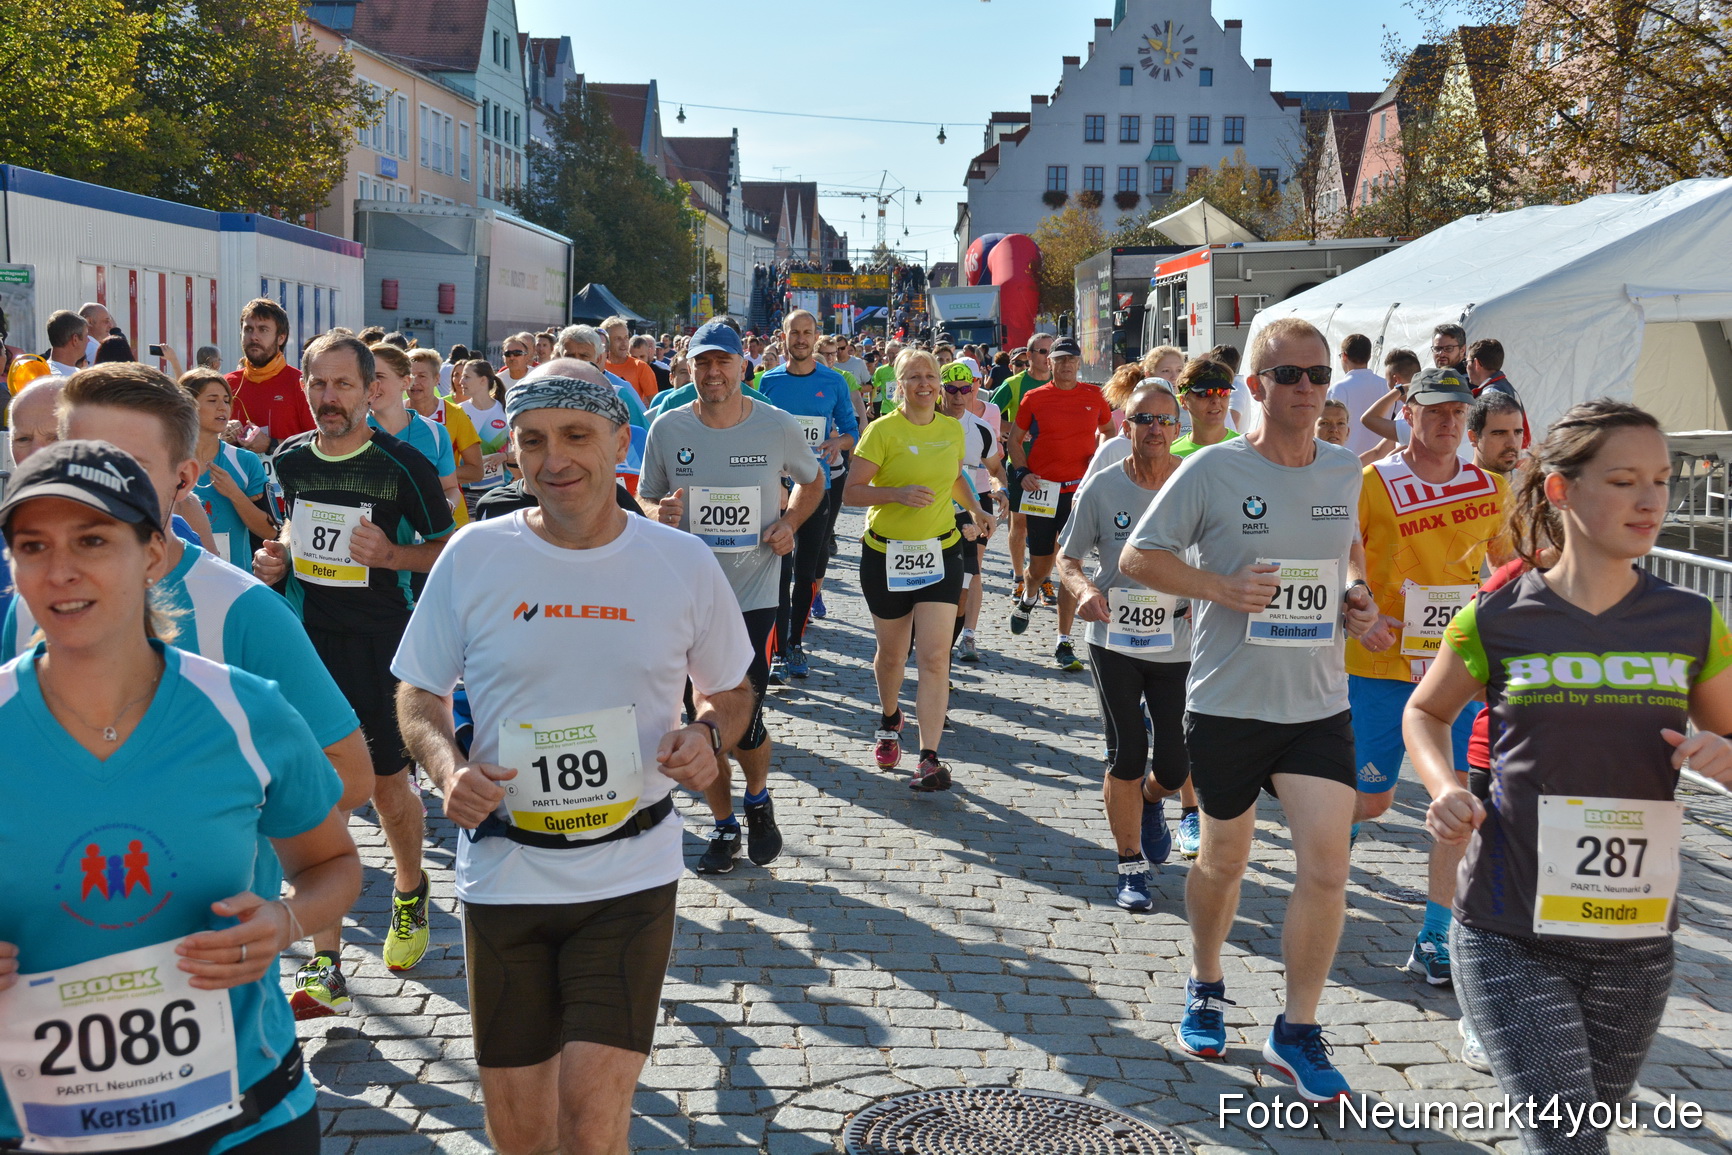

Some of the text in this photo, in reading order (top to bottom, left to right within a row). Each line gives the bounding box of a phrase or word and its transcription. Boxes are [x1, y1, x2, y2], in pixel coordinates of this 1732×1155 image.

[822, 274, 857, 286] START
[730, 455, 767, 465] BOCK
[67, 463, 122, 493] PUMA
[710, 493, 740, 501] BOCK
[1028, 489, 1048, 502] 201
[311, 509, 346, 523] BOCK
[700, 505, 750, 526] 2092
[1028, 505, 1046, 513] Volkmar
[1312, 506, 1349, 517] BOCK
[1399, 502, 1500, 537] MAX BÖGL
[312, 526, 341, 552] 87
[715, 537, 736, 546] Jack
[303, 551, 343, 563] PARTL Neumarkt
[894, 552, 935, 570] 2542
[312, 564, 337, 578] Peter
[1281, 568, 1318, 578] BOCK
[906, 577, 926, 586] Sonja
[1128, 594, 1157, 603] BOCK
[1266, 584, 1327, 611] 2190
[1428, 592, 1460, 600] BOCK
[544, 604, 635, 622] KLEBL
[1119, 605, 1165, 627] 2489
[1270, 625, 1317, 637] Reinhard
[1131, 637, 1151, 646] Peter
[1501, 652, 1695, 693] BOCK
[1508, 692, 1564, 706] inspired
[1569, 692, 1589, 706] by
[1594, 693, 1643, 704] smart
[534, 725, 597, 745] BOCK
[532, 750, 608, 793] 189
[1358, 773, 1388, 783] adidas
[532, 794, 604, 807] PARTL Neumarkt
[544, 812, 609, 832] Guenter
[1584, 809, 1645, 825] BOCK
[1576, 836, 1648, 878] 287
[1547, 866, 1553, 874] A
[1570, 882, 1641, 893] PARTL Neumarkt
[1581, 902, 1637, 921] Sandra
[59, 966, 162, 1000] BOCK
[34, 998, 201, 1076] 2086
[17, 1069, 26, 1078] C
[56, 1070, 174, 1096] PARTL Neumarkt
[80, 1100, 176, 1132] Kerstin
